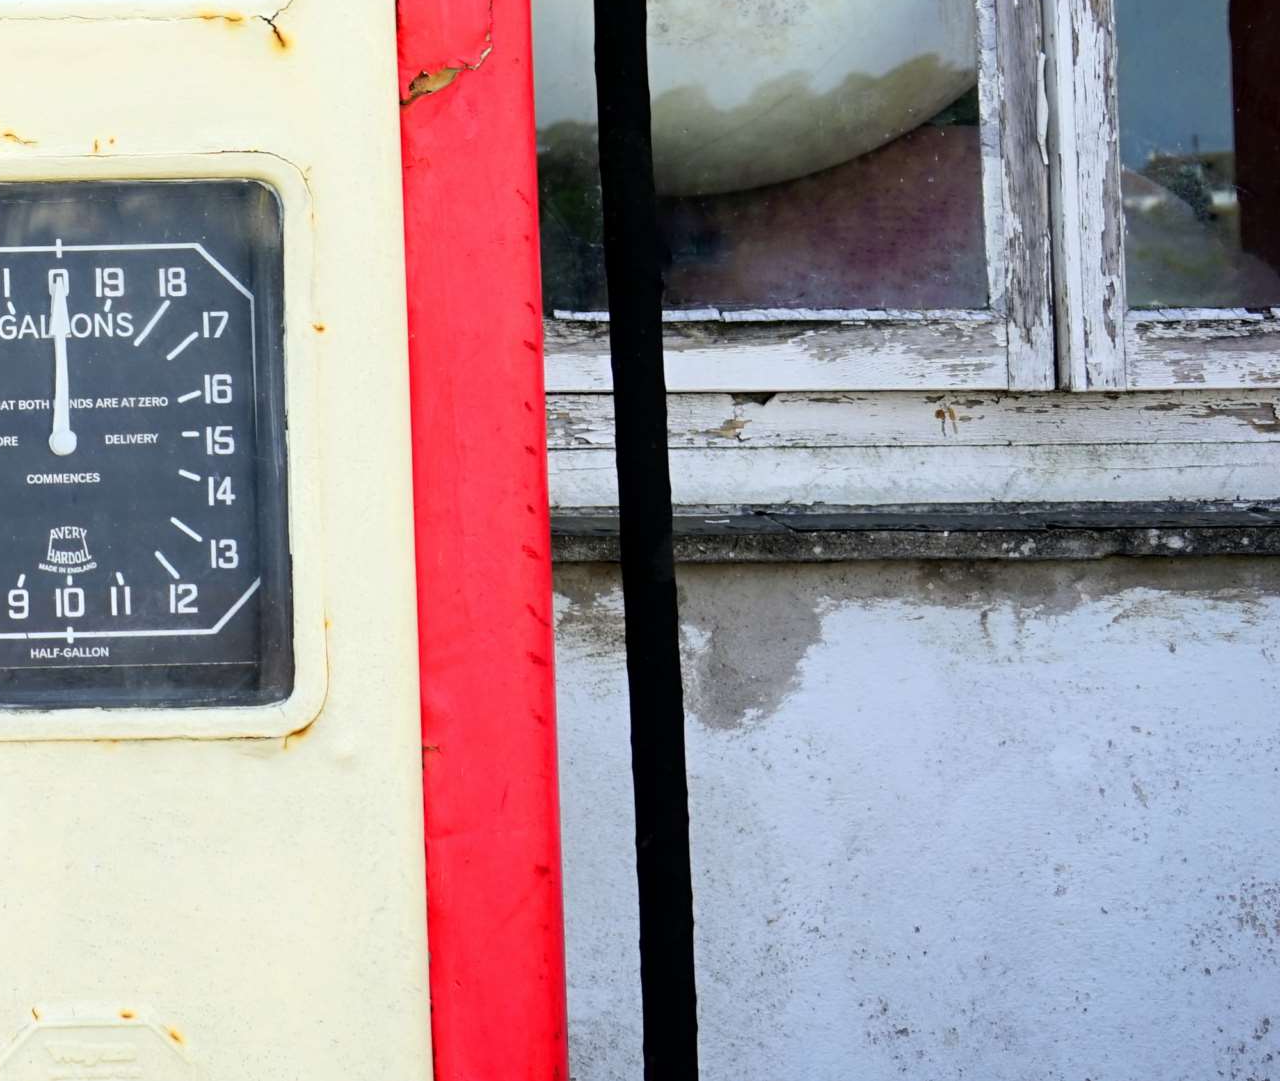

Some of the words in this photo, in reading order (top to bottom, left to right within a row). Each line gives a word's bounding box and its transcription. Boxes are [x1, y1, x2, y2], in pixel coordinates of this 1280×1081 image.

[3, 268, 10, 297] 1
[95, 267, 125, 297] 19
[159, 267, 187, 297] 18
[202, 311, 229, 338] 17
[18, 399, 50, 410] BOTH
[53, 397, 94, 409] NDS
[95, 398, 119, 408] ARE
[120, 397, 136, 407] AT
[138, 396, 169, 407] ZERO
[204, 374, 232, 404] 16
[105, 433, 159, 444] DELIVERY
[206, 426, 235, 455] 15
[26, 472, 101, 484] COMMENCES
[208, 476, 236, 506] 14
[50, 526, 87, 540] AVERY
[38, 563, 58, 573] MADE
[47, 549, 92, 565] HARDOLL
[210, 539, 239, 569] 13
[8, 589, 30, 619] 9
[55, 587, 85, 617] 10
[111, 585, 132, 616] 11
[170, 583, 199, 614] 12
[30, 647, 109, 659] HALF-GALLON
